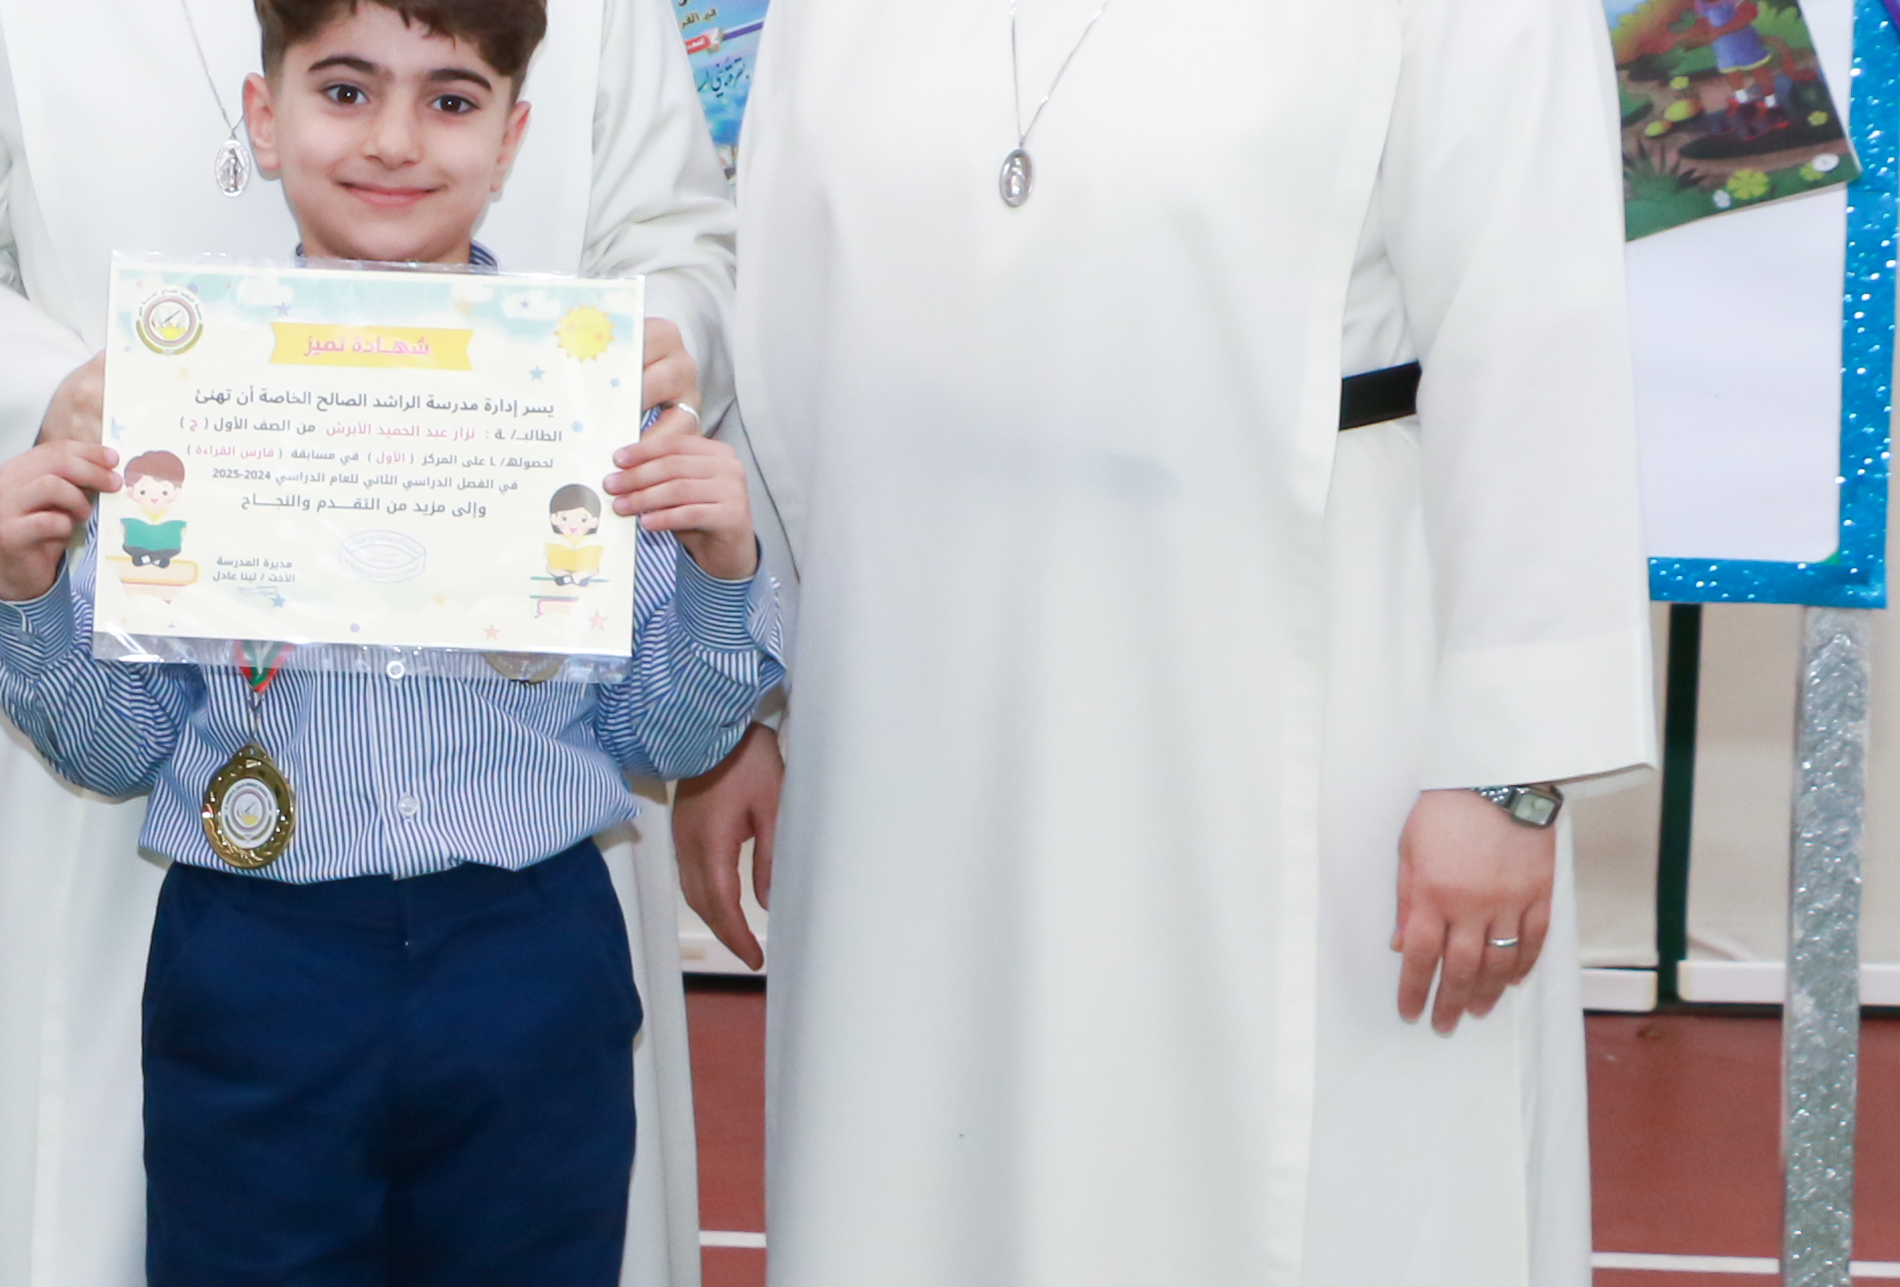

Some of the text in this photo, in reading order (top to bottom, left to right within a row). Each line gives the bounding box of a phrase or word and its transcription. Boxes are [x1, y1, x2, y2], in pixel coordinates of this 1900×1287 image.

[303, 335, 346, 358] تميز
[236, 384, 254, 407] أن
[258, 387, 312, 406] الخاصة
[316, 392, 367, 412] الصالح
[372, 393, 421, 412] الراشد
[425, 393, 479, 414] مدرسة
[484, 397, 518, 418] إدارة
[521, 402, 555, 418] يسر
[213, 416, 248, 433] الأول
[252, 419, 291, 433] الصف
[296, 422, 316, 436] من
[325, 421, 372, 438] الأبرش
[376, 424, 420, 439] الحميد
[425, 427, 448, 440] عبد
[452, 426, 476, 443] نزار
[195, 444, 236, 458] القراءة
[291, 448, 336, 461] مسابقة
[340, 451, 360, 466] في
[421, 453, 458, 467] المركز
[461, 455, 485, 468] على
[274, 470, 326, 487] الدراسي
[329, 473, 359, 487] للعام
[363, 473, 398, 490] الثاني
[402, 476, 452, 492] الدراسي
[456, 478, 494, 491] الفصل
[498, 480, 519, 495] في
[386, 499, 408, 515] من
[412, 499, 447, 517] مزيد
[451, 499, 487, 519] وإلى
[216, 555, 293, 570] مديرة المدرسة
[212, 569, 238, 583] عادل
